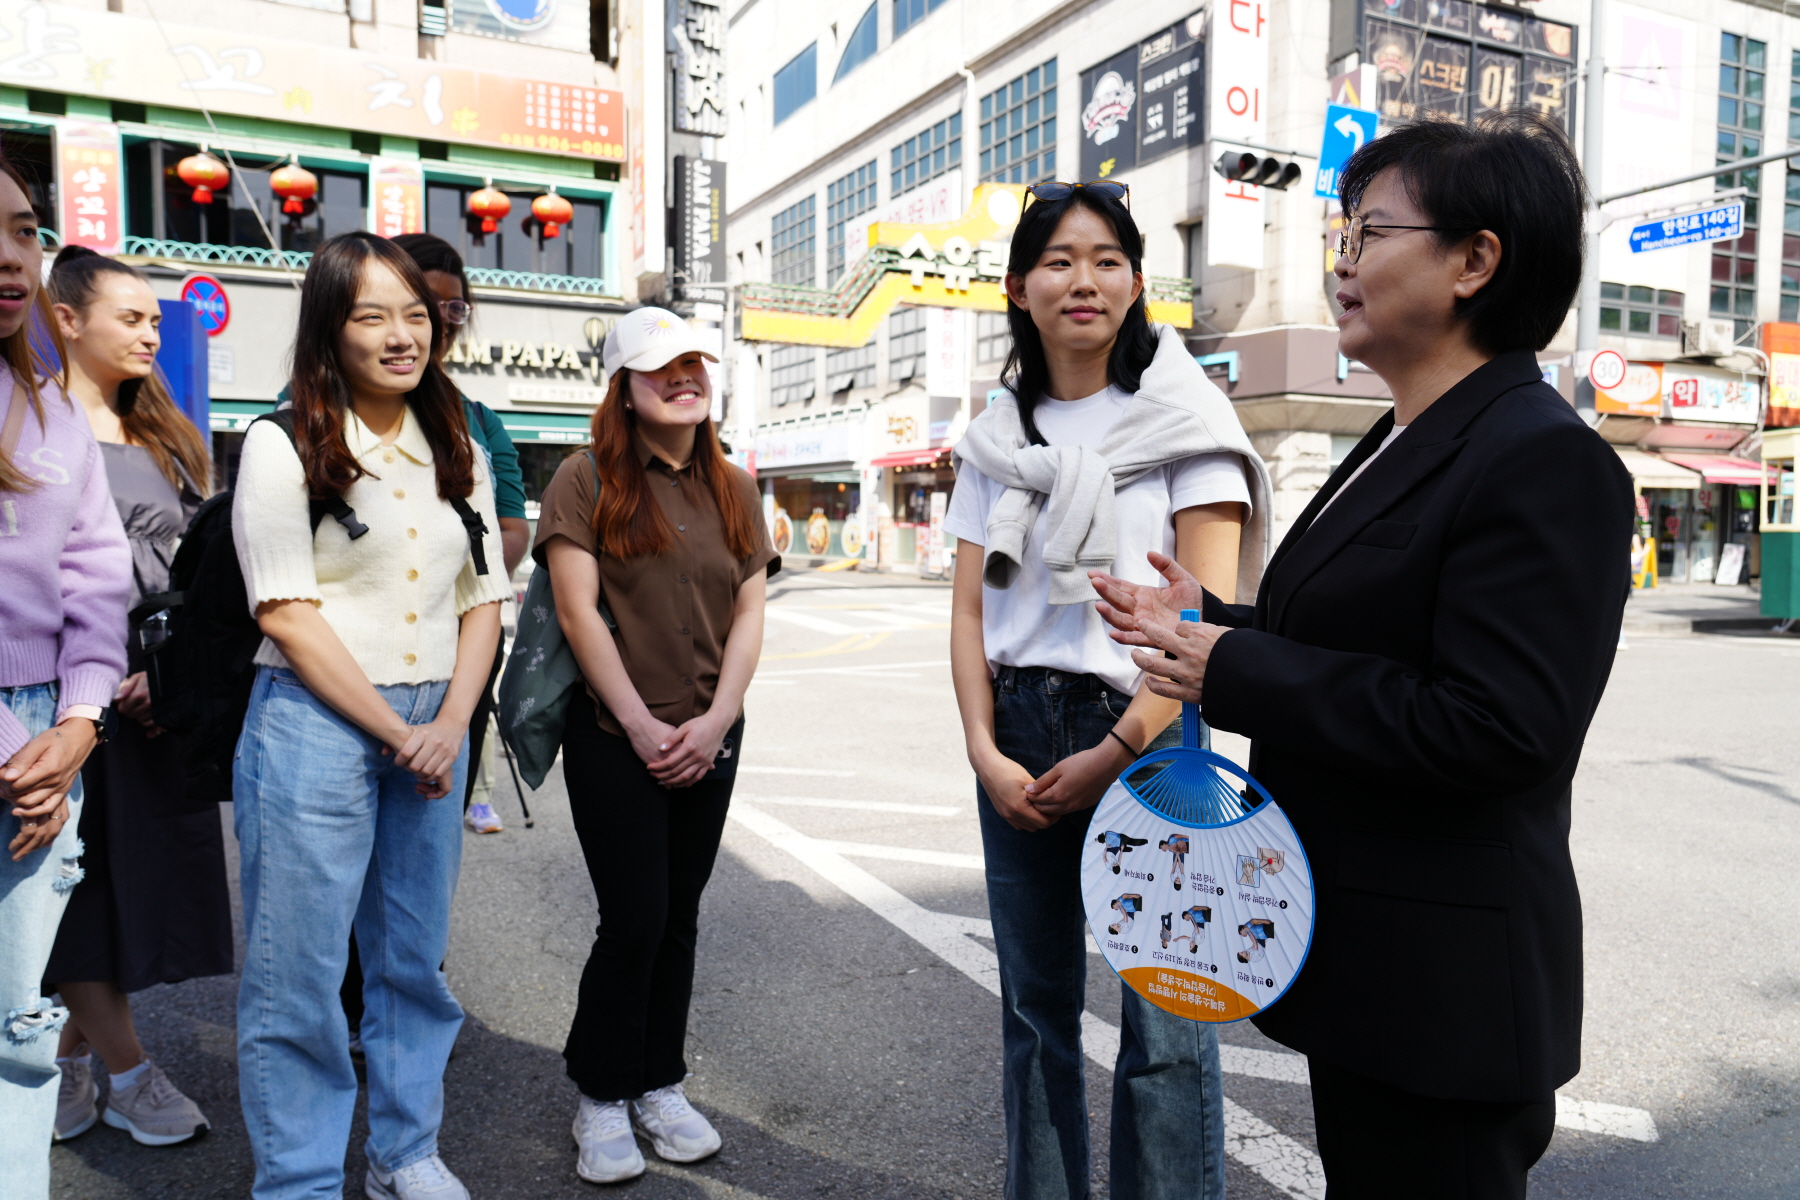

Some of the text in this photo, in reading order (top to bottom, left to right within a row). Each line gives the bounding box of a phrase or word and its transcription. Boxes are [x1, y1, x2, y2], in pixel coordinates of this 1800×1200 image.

[1419, 59, 1468, 93] 스크린
[692, 159, 712, 259] JAM PAPA
[1661, 206, 1739, 237] 한천로140길
[1641, 231, 1703, 251] Hancheon-ro
[1704, 223, 1738, 241] 140-gil
[442, 336, 583, 370] AM PAPA
[1597, 360, 1620, 380] 30
[1124, 869, 1146, 881] 회복자세
[1191, 882, 1215, 894] 중단없는
[1238, 891, 1251, 902] 실시
[1252, 894, 1278, 908] 가슴압박
[1152, 951, 1164, 960] 신고
[1164, 954, 1176, 963] 119
[1184, 957, 1196, 968] 요청
[1197, 961, 1210, 972] 도움
[1237, 971, 1250, 983] 확인
[1250, 975, 1264, 986] 반응
[1157, 971, 1217, 997] (가슴압박소생술)
[1148, 982, 1227, 1012] 심폐소생술의 시행방법
